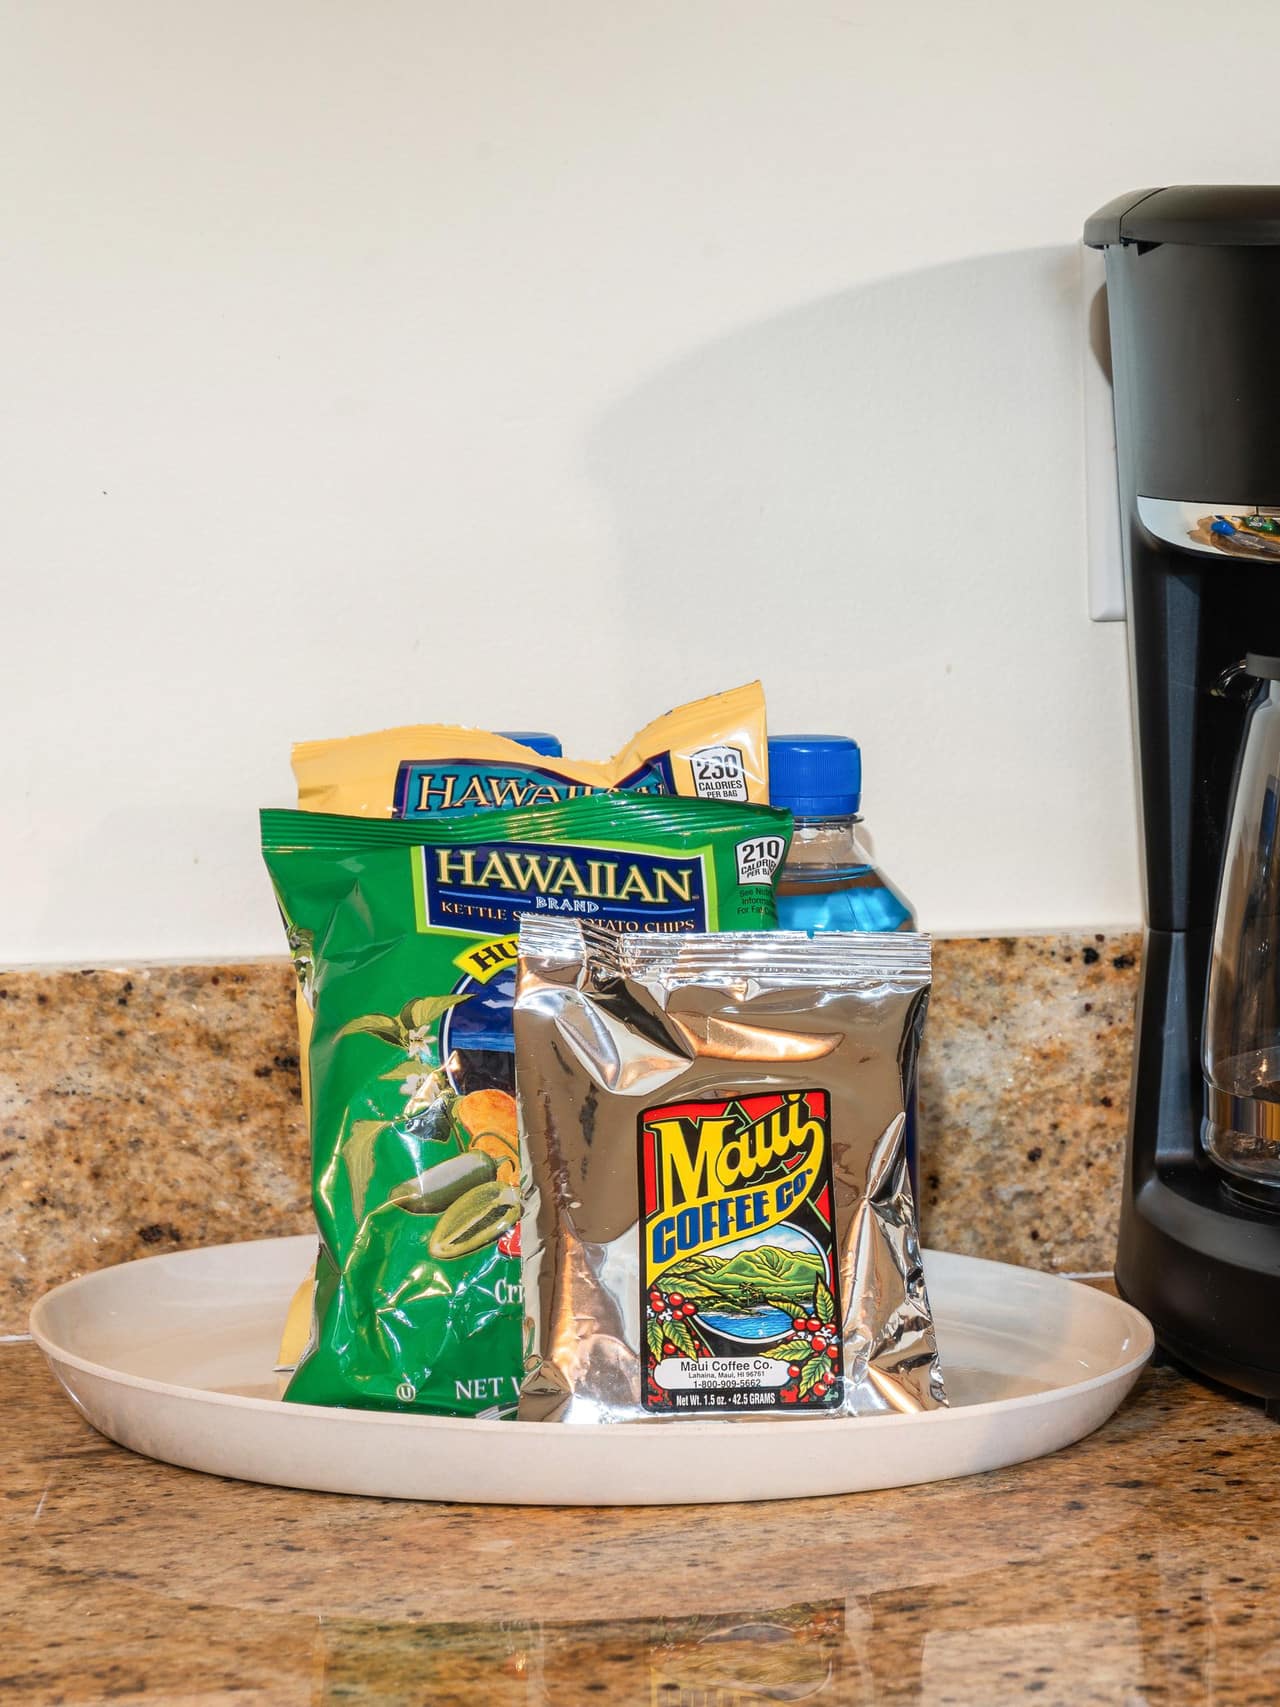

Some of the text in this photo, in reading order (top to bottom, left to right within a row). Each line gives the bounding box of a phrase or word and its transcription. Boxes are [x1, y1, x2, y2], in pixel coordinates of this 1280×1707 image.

[697, 754, 739, 780] 230
[416, 774, 664, 811] HAWA
[698, 780, 743, 792] CALORIES
[707, 789, 738, 799] PER BAG
[742, 840, 780, 864] 210
[434, 849, 693, 904] HAWAIIAN
[746, 868, 761, 879] PER
[535, 896, 600, 913] BRAND
[441, 901, 507, 921] KETTLE
[583, 916, 639, 933] TATO
[643, 919, 696, 934] CHIPS
[650, 1093, 816, 1209] Maui
[653, 1189, 770, 1264] COFFEE
[680, 1359, 773, 1372] Maui Coffee Co.
[688, 1372, 717, 1380] Lahaina,
[718, 1371, 736, 1379] Maui,
[455, 1376, 504, 1400] NET
[676, 1392, 776, 1406] Net Wt. 1.5 oz. 42.5 GRAMS
